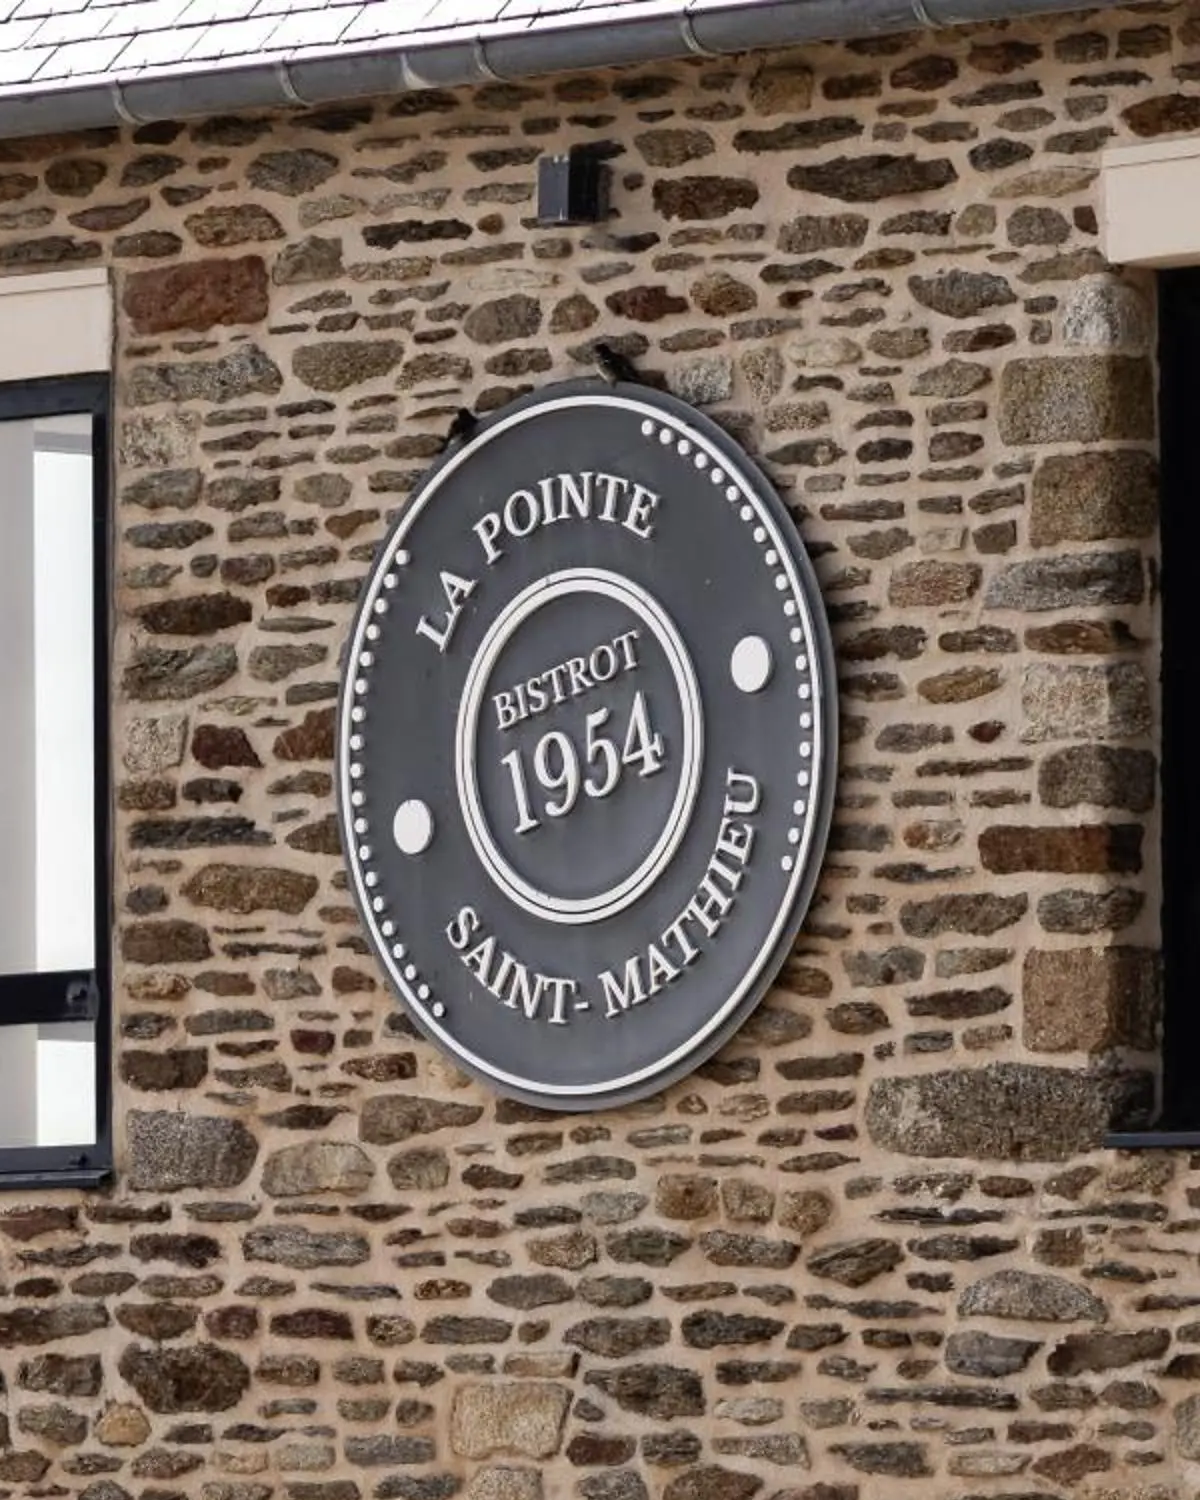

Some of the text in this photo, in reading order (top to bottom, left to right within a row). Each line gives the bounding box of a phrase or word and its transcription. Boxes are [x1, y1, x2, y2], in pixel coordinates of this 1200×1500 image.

[414, 470, 661, 653] LA POINTE
[491, 629, 642, 731] BISTROT
[499, 690, 666, 836] 1954
